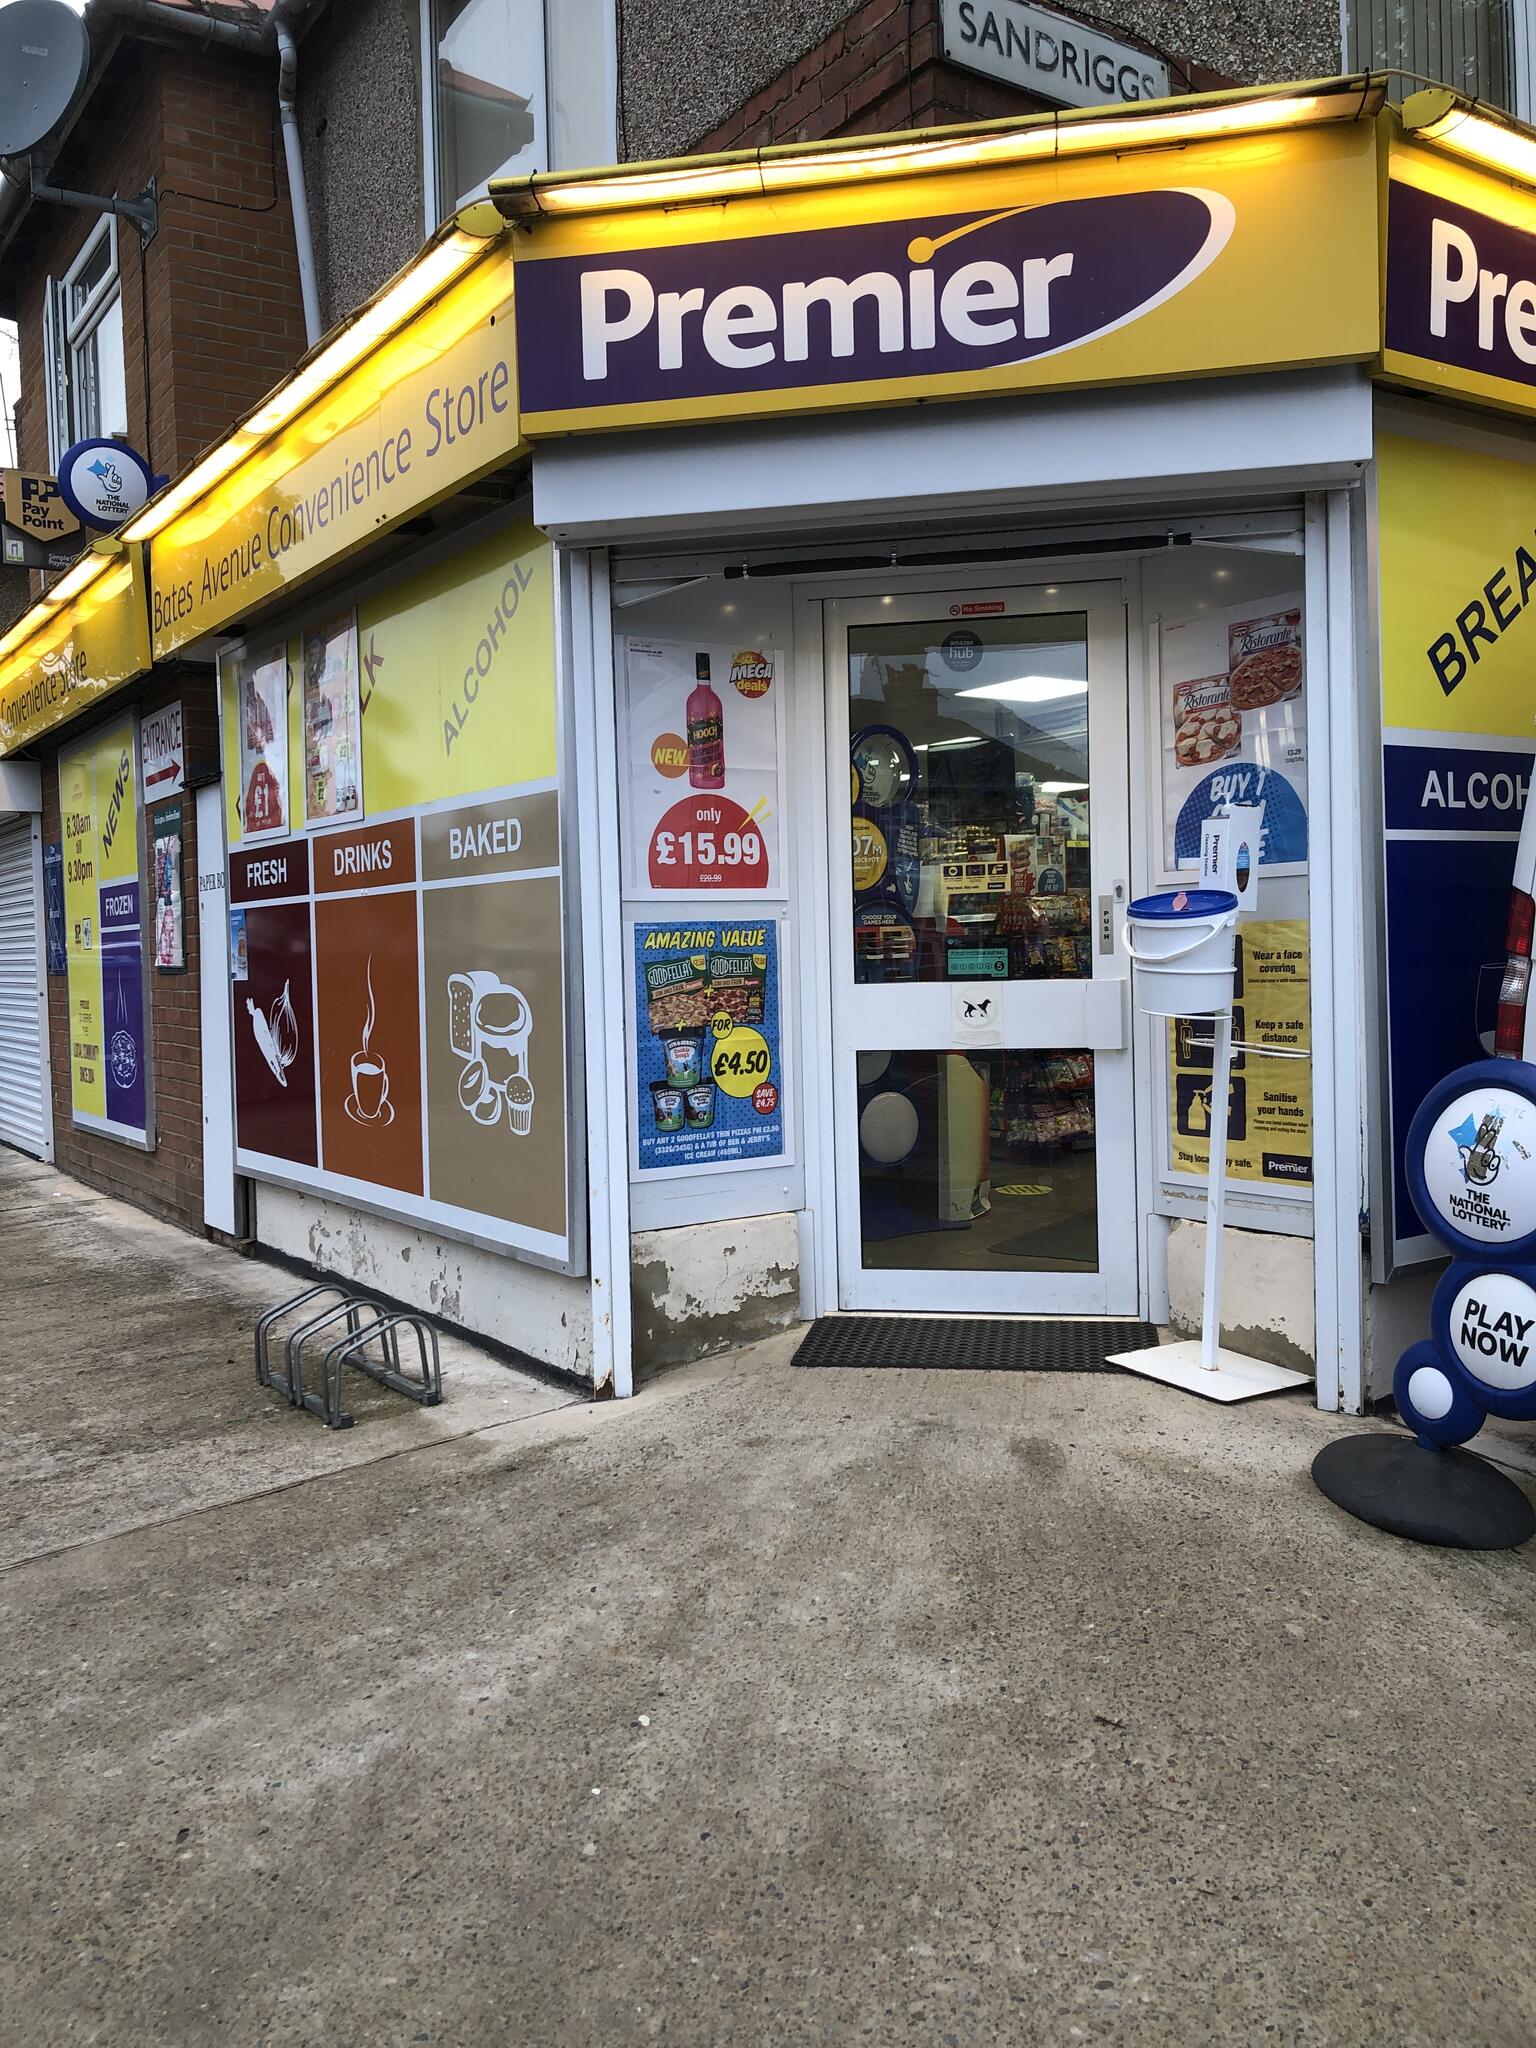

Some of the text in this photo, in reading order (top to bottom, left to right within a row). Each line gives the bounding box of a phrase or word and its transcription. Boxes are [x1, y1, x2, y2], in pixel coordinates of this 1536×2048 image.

[959, 2, 1156, 102] SANDRIGGS
[580, 237, 1074, 381] Premier
[96, 499, 130, 509] NATIONAL
[154, 361, 509, 634] Bates Avenue Convenience Store
[22, 502, 49, 518] Pay
[98, 505, 128, 515] LOTTERY
[22, 515, 64, 531] Point
[1427, 528, 1536, 697] BREA
[1240, 627, 1293, 651] Ristorante
[444, 561, 534, 757] ALCOHOL
[949, 646, 974, 659] hub
[729, 662, 774, 683] MEGA
[736, 680, 768, 692] deals
[1184, 688, 1232, 710] Ristorante
[143, 710, 182, 764] ENTRANCE
[693, 726, 718, 740] HOOCH
[654, 748, 688, 765] NEW
[1210, 771, 1266, 802] BUY 1
[102, 749, 130, 859] NEWS
[254, 783, 269, 818] £1
[67, 813, 91, 839] 6.30am
[696, 808, 722, 824] only
[450, 818, 522, 860] BAKED
[656, 831, 761, 866] £15.99
[333, 839, 392, 876] DRINKS
[1211, 834, 1220, 875] Premier
[68, 859, 93, 885] 9.30pm
[247, 858, 287, 888] FRESH
[200, 873, 216, 892] PAPER
[105, 894, 133, 917] FROZEN
[644, 929, 766, 950] AMAZING VALUE
[1253, 950, 1274, 960] Wear
[1283, 950, 1303, 960] face
[711, 957, 753, 976] GOODFELLA'S
[1259, 963, 1296, 974] covering
[712, 1018, 731, 1032] FOR
[1255, 1019, 1304, 1031] Keep a safe
[1262, 1032, 1298, 1043] distance
[714, 1050, 768, 1077] £4.50
[756, 1088, 775, 1098] SAVE
[756, 1098, 775, 1108] £4.75
[1263, 1092, 1297, 1103] Sanitise
[1257, 1106, 1304, 1117] your hands
[656, 1137, 669, 1145] ANY
[731, 1128, 752, 1137] PIZZAS
[694, 1142, 700, 1150] &
[718, 1139, 726, 1147] OF
[728, 1137, 740, 1146] BEN
[684, 1152, 694, 1160] ICE
[1178, 1152, 1194, 1163] Stay
[1194, 1153, 1210, 1164] loca
[1234, 1159, 1253, 1168] safe.
[1268, 1160, 1309, 1174] Premier
[1466, 1188, 1491, 1206] THE
[1449, 1194, 1512, 1222] NATIONAL
[1452, 1206, 1508, 1232] LOTTERY
[1463, 1298, 1536, 1342] PLAY
[1460, 1322, 1530, 1368] NOW
